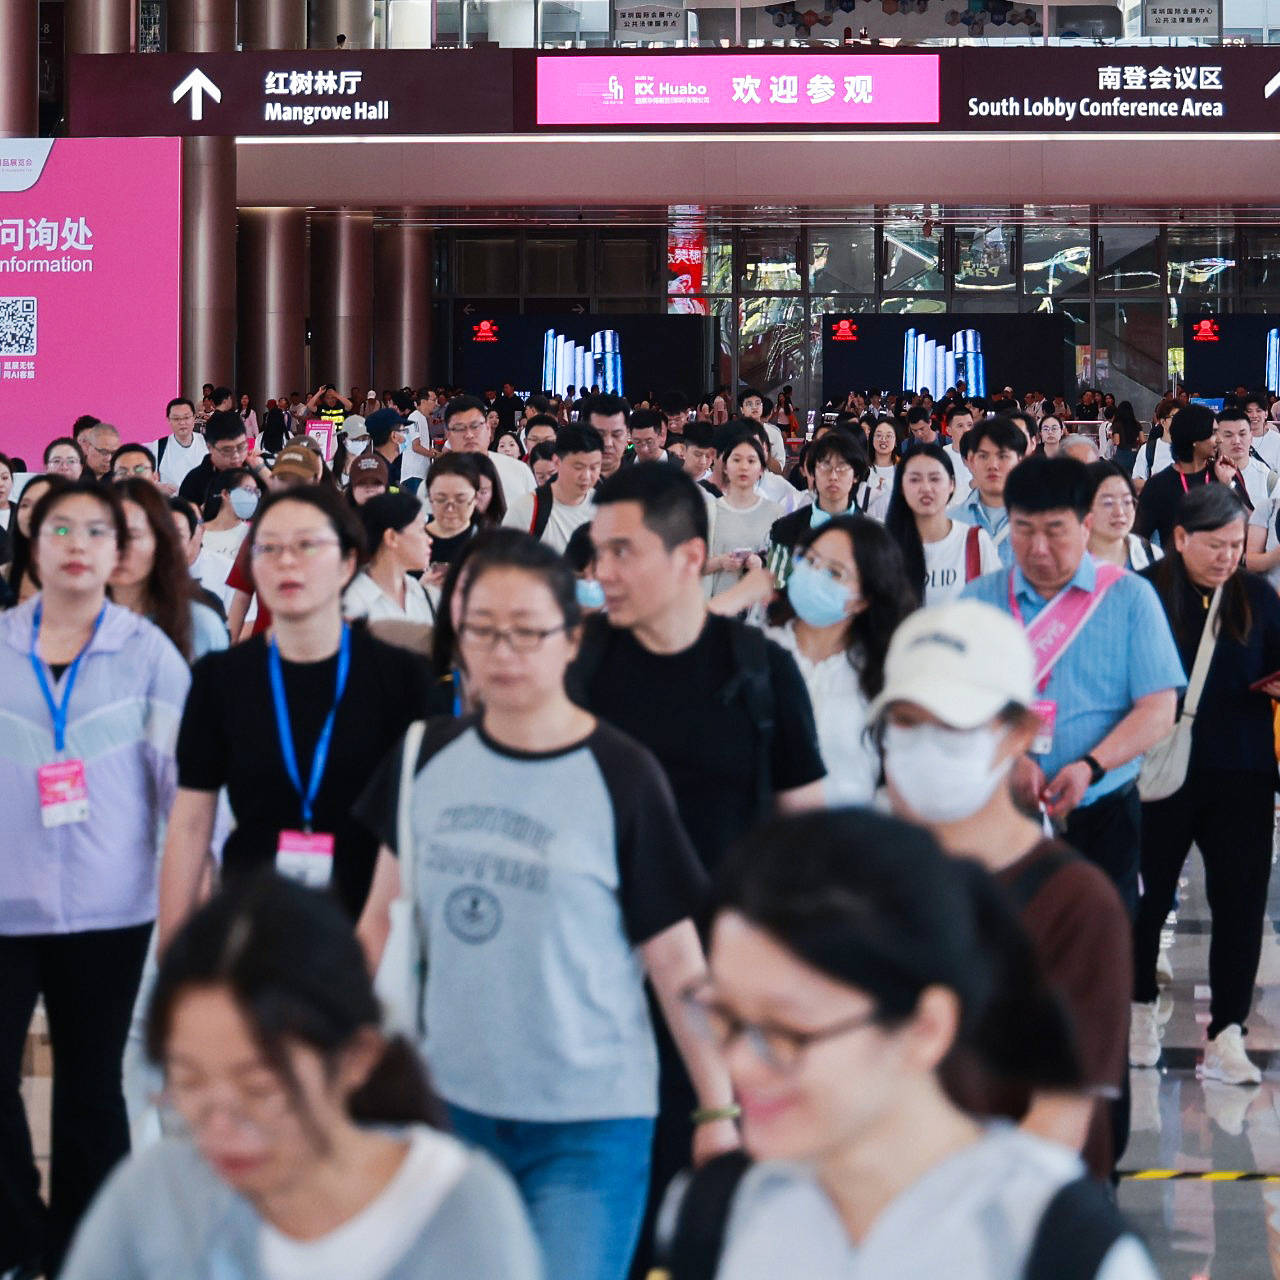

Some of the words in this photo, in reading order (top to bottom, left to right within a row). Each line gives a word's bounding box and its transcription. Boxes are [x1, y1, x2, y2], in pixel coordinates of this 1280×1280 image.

[619, 10, 682, 20] 深圳国际会展中心
[1150, 7, 1215, 17] 深圳国际会展中心
[1154, 16, 1210, 25] 公共法律服务点
[623, 20, 678, 29] 公共法律服务点
[263, 70, 363, 95] 红树林厅
[1097, 66, 1223, 91] 南登会议区
[659, 82, 708, 96] Huabo
[731, 74, 874, 104] 欢迎参观
[264, 101, 351, 125] Mangrove
[353, 99, 390, 121] Hall
[968, 97, 1020, 117] South
[1023, 97, 1076, 121] Lobby
[1078, 97, 1177, 117] Conference
[1179, 97, 1224, 117] Area
